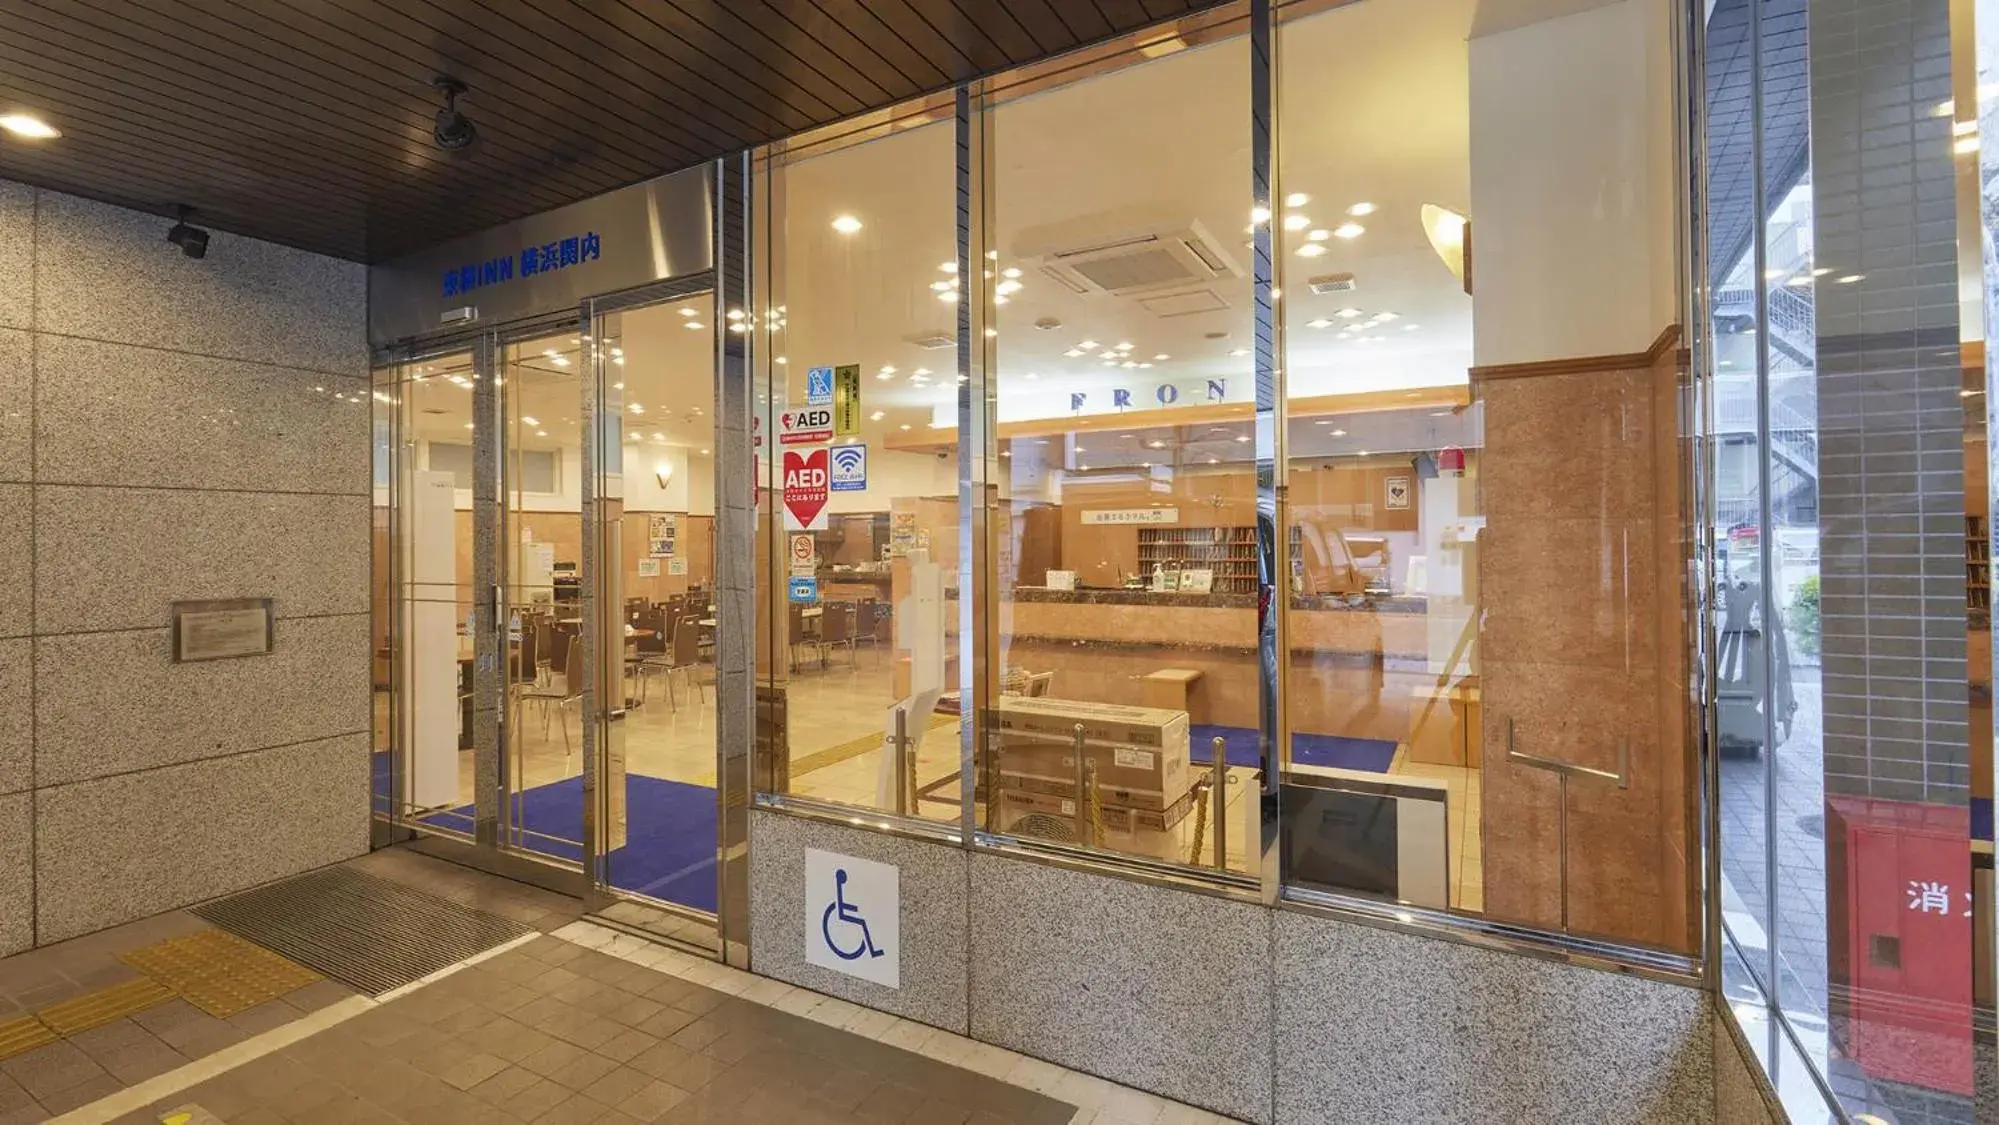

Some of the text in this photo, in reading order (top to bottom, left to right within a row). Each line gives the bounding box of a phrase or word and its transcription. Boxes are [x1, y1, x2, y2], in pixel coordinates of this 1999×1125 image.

[520, 232, 600, 278] 横浜関内
[796, 410, 830, 428] AED
[785, 468, 826, 489] AED
